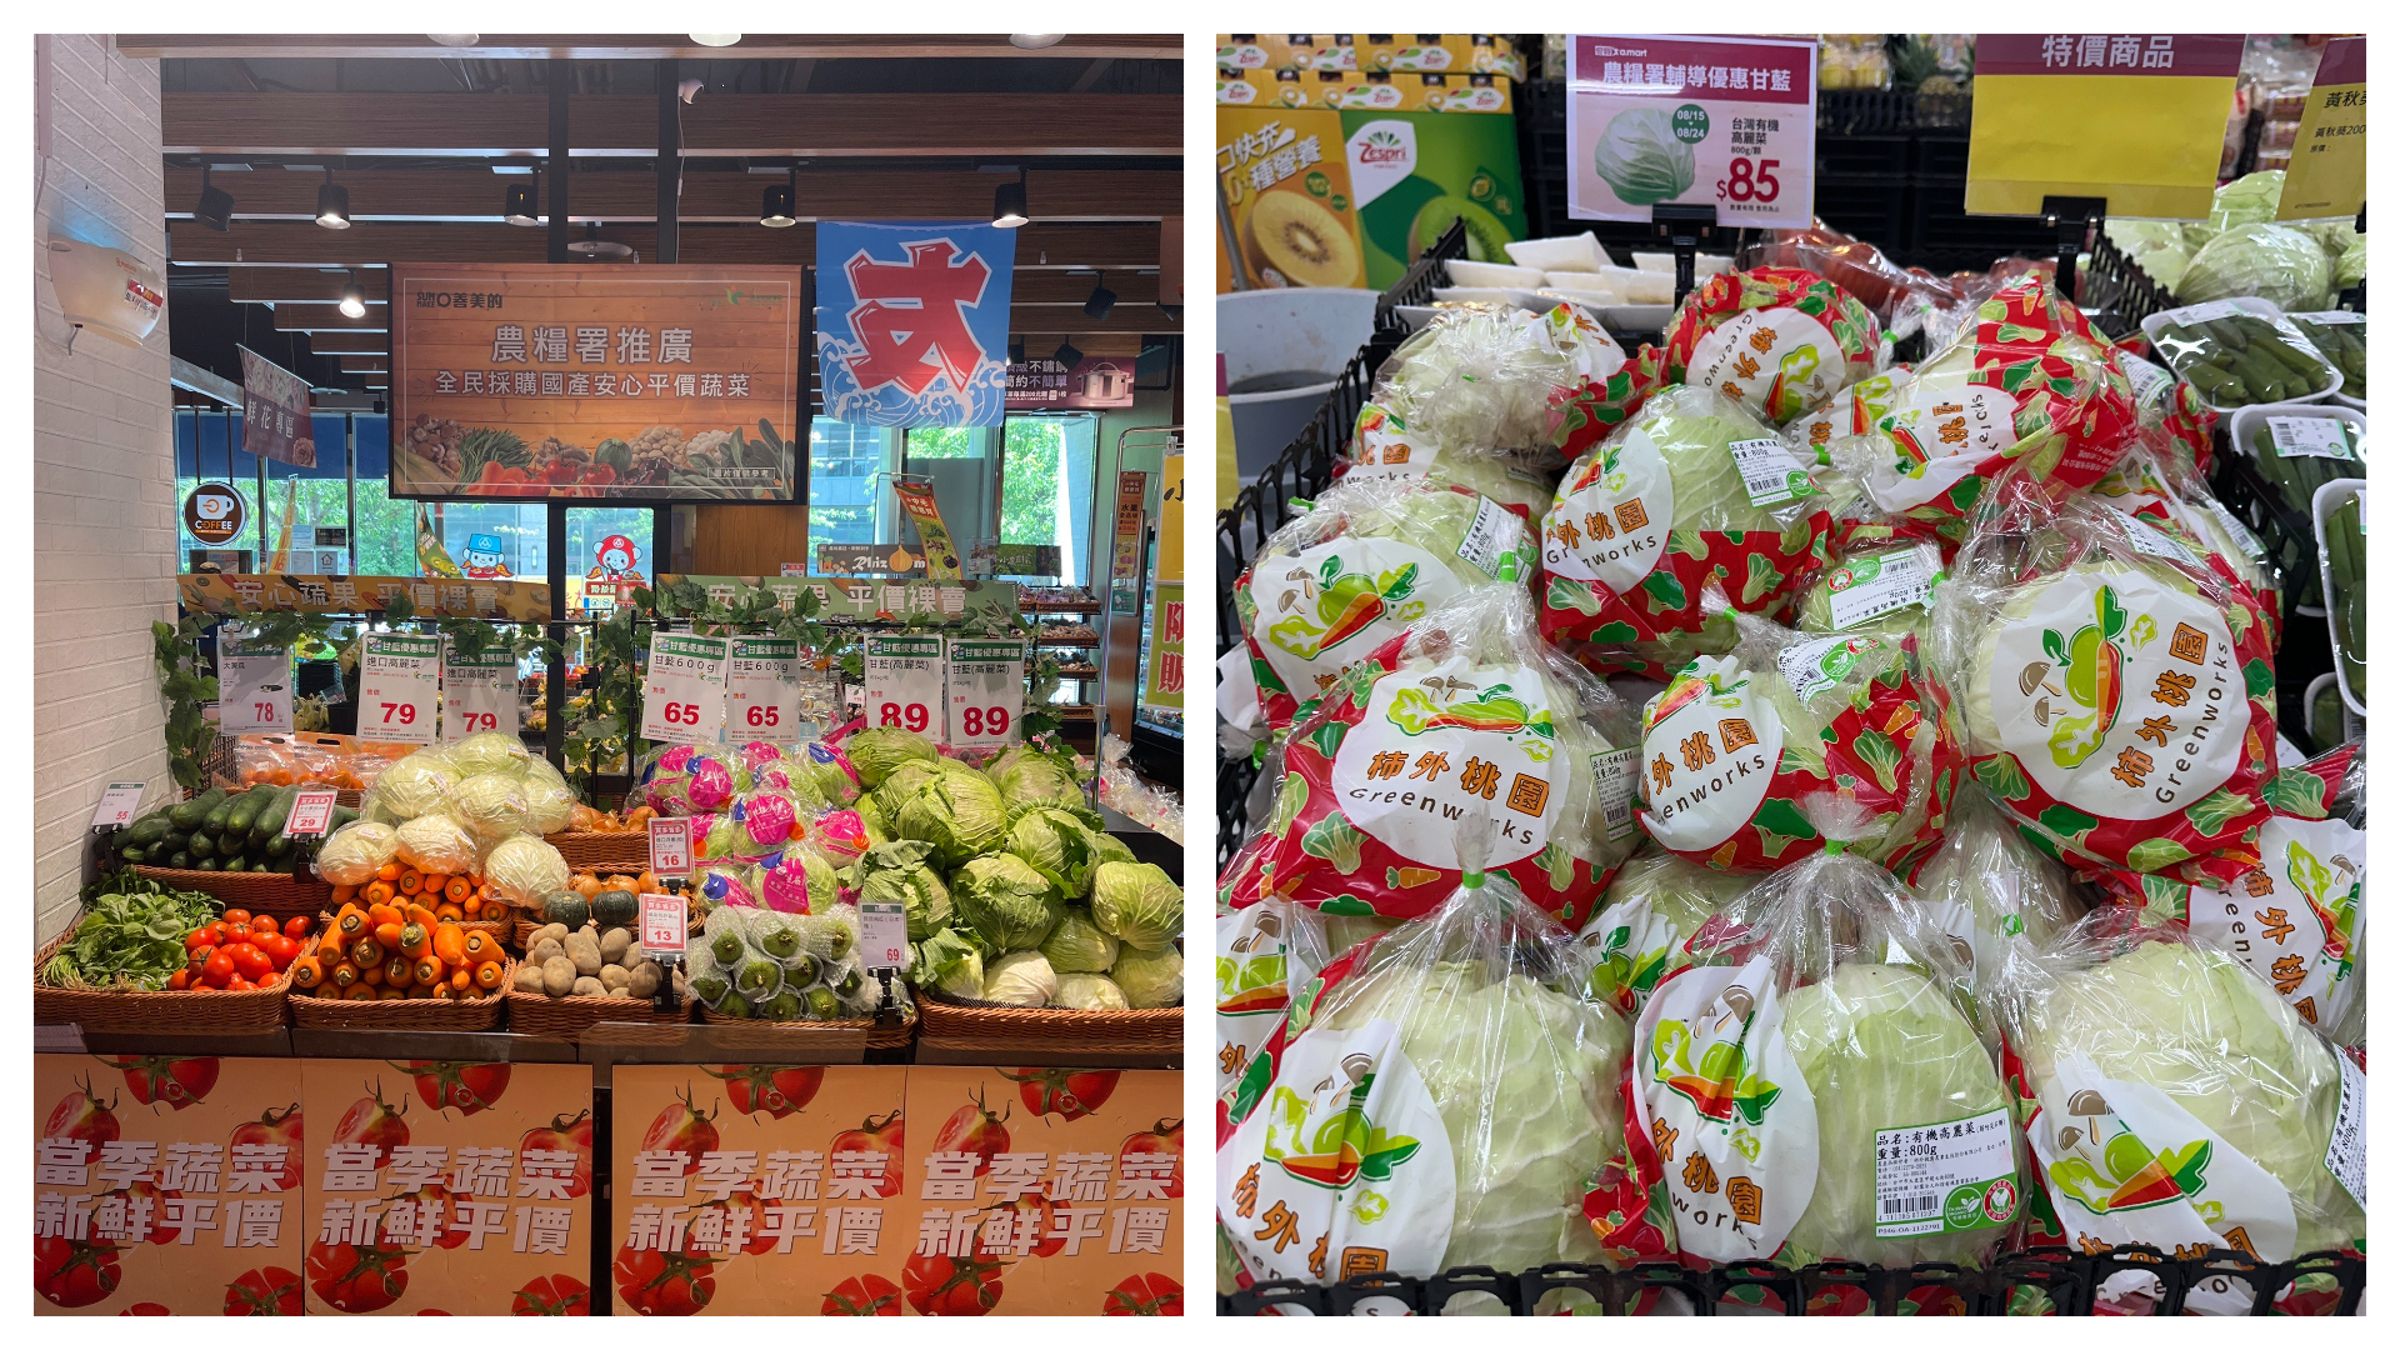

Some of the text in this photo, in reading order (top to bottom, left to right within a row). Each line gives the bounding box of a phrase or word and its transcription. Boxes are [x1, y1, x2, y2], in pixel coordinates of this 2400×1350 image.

[2042, 34, 2175, 69] 特價商品
[1603, 61, 1792, 92] 農糧署輔導優惠甘藍
[1676, 110, 1705, 122] 08/15
[1731, 117, 1780, 133] 台灣有機
[1676, 127, 1705, 139] 08/24
[1730, 131, 1767, 145] 高麗菜
[1357, 141, 1407, 164] Zespri
[1716, 157, 1780, 203] $85
[491, 325, 693, 364] 農糧署推廣
[434, 370, 751, 398] 全民採購國產安心平價蔬菜
[194, 520, 233, 530] COFFEE
[1546, 535, 1657, 569] Grnworks
[233, 581, 499, 613] 安心蔬果 平價裸賣
[847, 584, 967, 614] 平價裸賣
[254, 702, 274, 722] 78
[380, 702, 416, 725] 79
[664, 701, 700, 726] 65
[746, 705, 780, 727] 65
[880, 702, 930, 733] 89
[2110, 621, 2208, 788] 柿外桃園
[462, 712, 497, 733] 79
[963, 706, 1010, 737] 89
[2155, 642, 2228, 804] Greenworks
[1367, 750, 1550, 818] 柿外桃園
[300, 818, 316, 827] 29
[1349, 787, 1534, 845] Greenwks
[662, 855, 680, 866] 16
[654, 930, 672, 941] 13
[886, 948, 900, 961] 69
[35, 1136, 290, 1194] 當季蔬菜
[322, 1143, 580, 1200] 當季蔬菜
[632, 1149, 891, 1202] 當季蔬菜
[920, 1151, 1179, 1202] 當季蔬菜
[34, 1193, 285, 1248] 新鮮平價
[319, 1197, 574, 1255] 新鮮平價
[628, 1203, 884, 1256] 新鮮平價
[917, 1206, 1171, 1258] 新鮮平價
